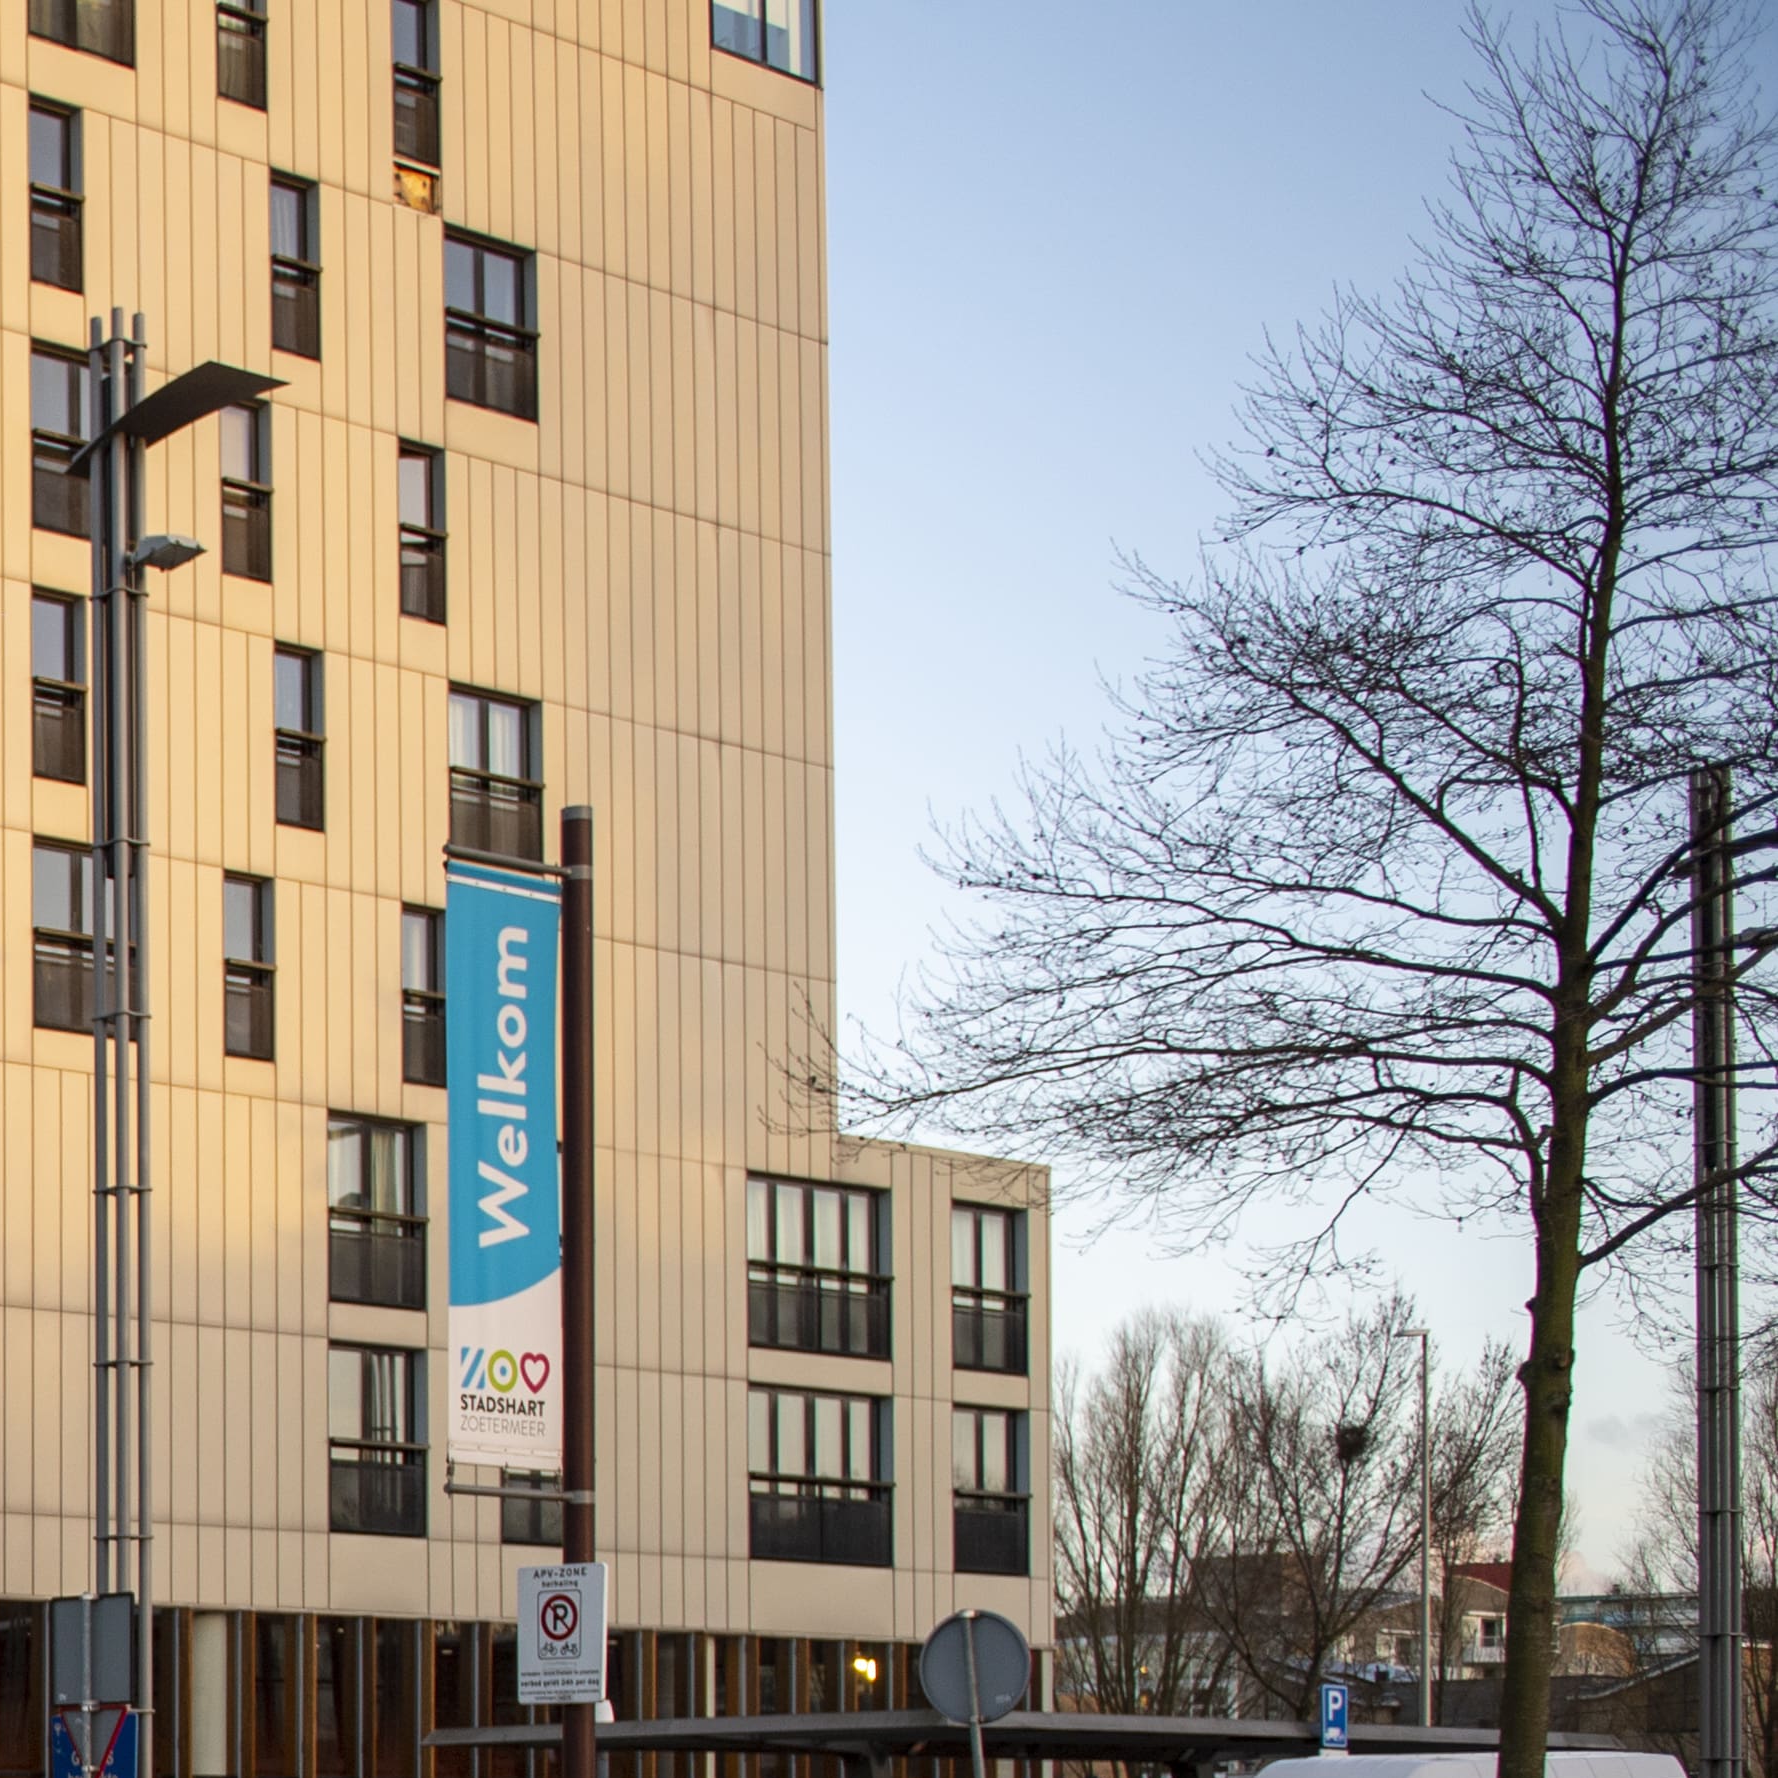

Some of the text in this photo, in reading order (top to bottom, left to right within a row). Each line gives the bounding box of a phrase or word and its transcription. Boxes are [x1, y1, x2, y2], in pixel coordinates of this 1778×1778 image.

[477, 925, 530, 1249] Welkom
[461, 1394, 545, 1417] STADSHART
[460, 1415, 546, 1437] ZOETERMEER
[533, 1567, 587, 1579] APV-ZONE
